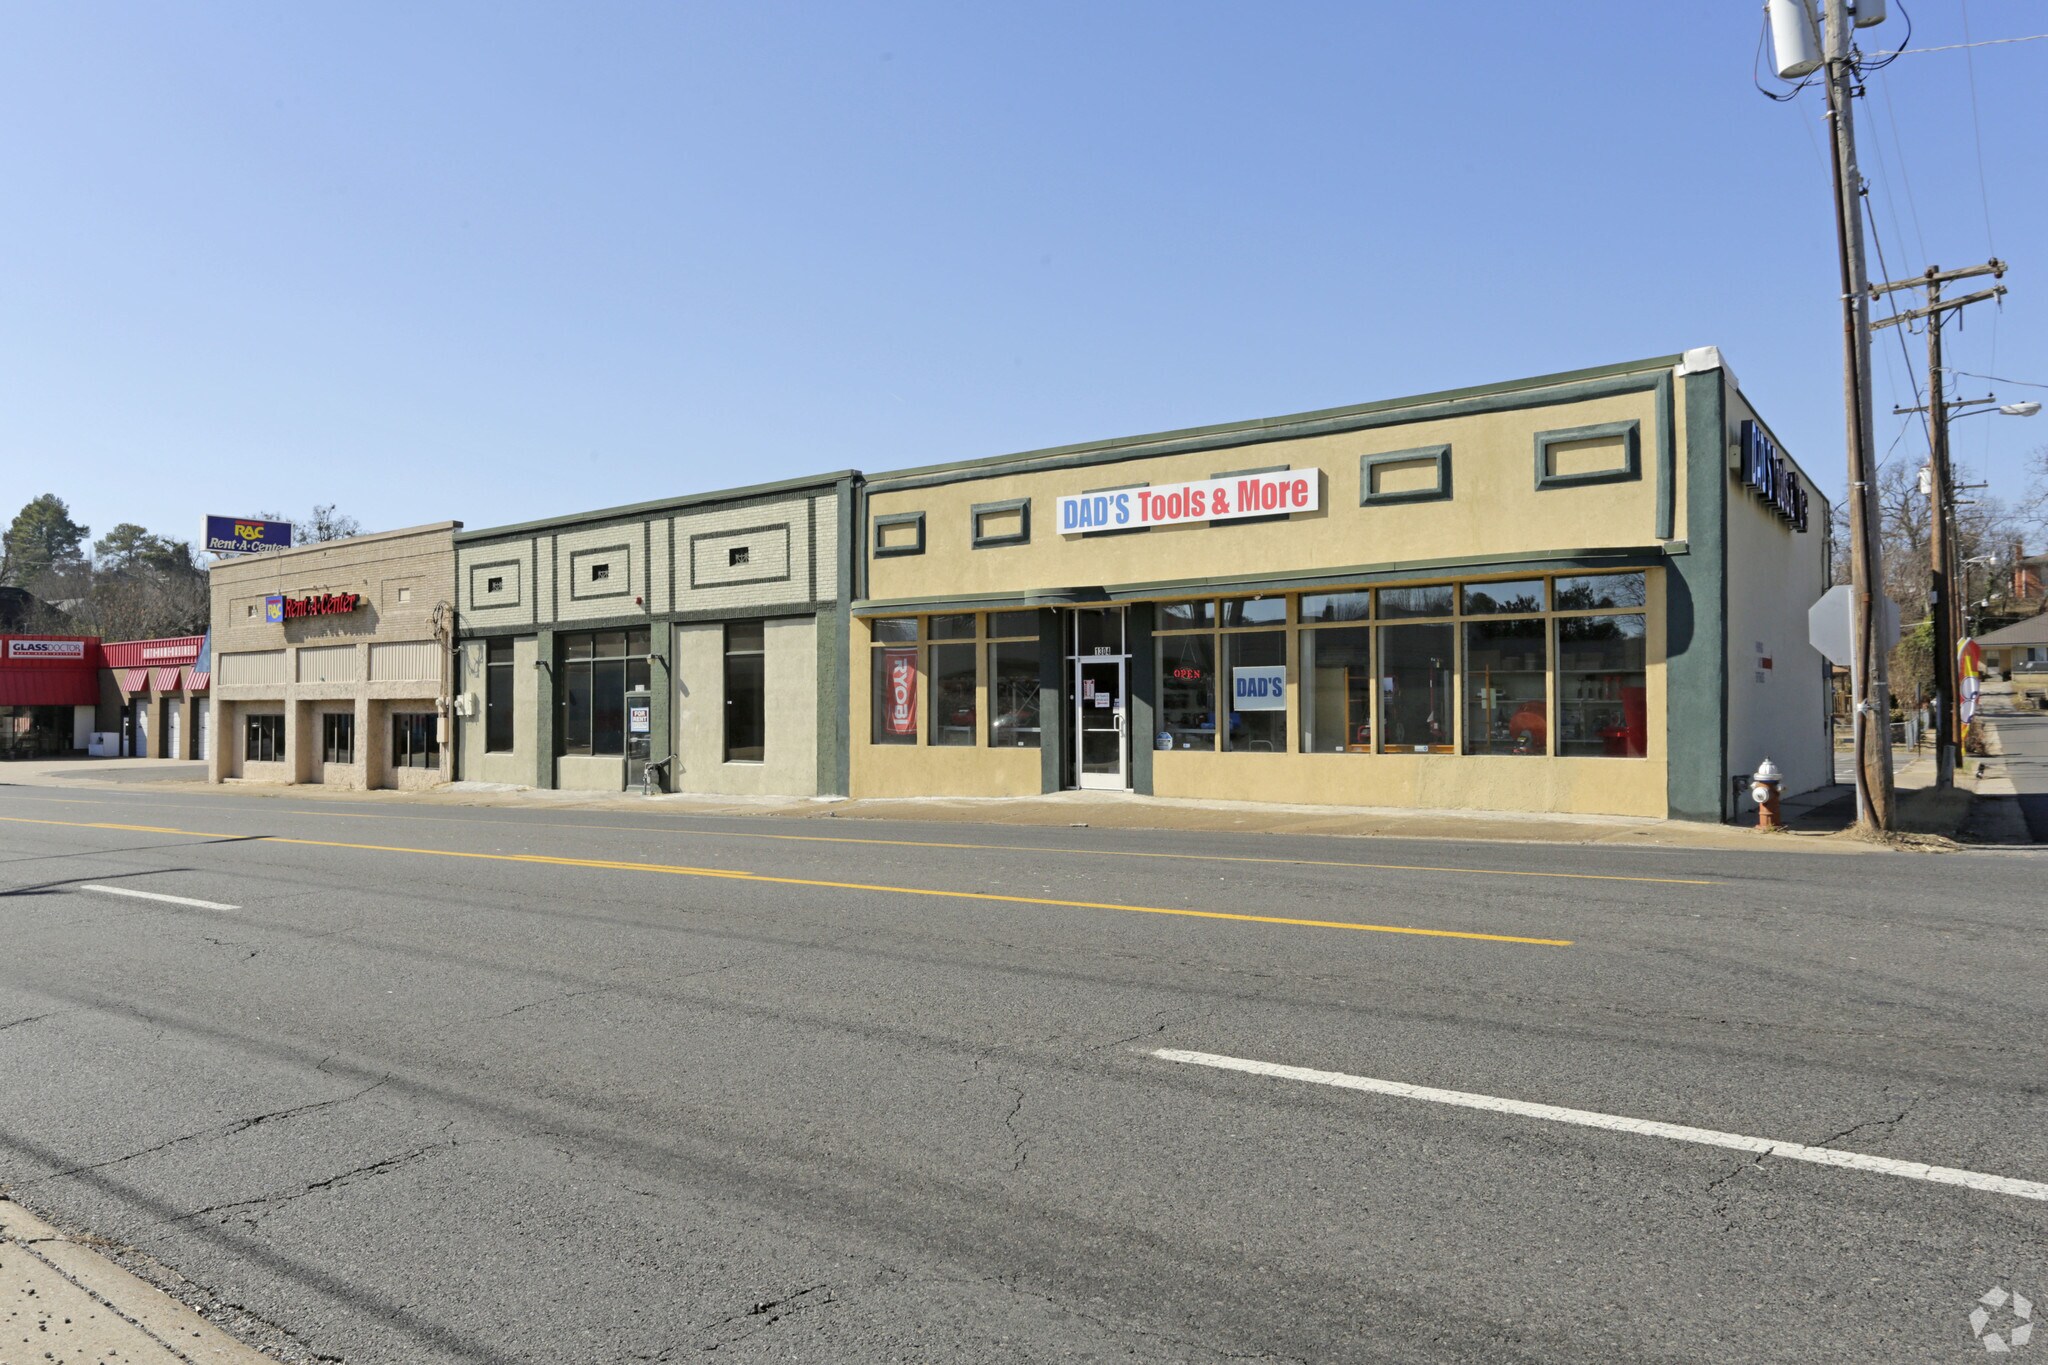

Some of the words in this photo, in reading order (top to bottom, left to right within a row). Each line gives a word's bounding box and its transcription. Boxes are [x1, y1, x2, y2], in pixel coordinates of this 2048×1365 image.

[1137, 486, 1206, 522] Tools
[1211, 487, 1230, 515] &
[1237, 478, 1309, 512] More
[234, 525, 264, 540] RAC
[267, 603, 282, 619] RAC
[1095, 647, 1110, 656] 1304
[1173, 669, 1201, 679] OPEN
[893, 658, 910, 725] RYOBI
[1236, 677, 1283, 698] DAD'S
